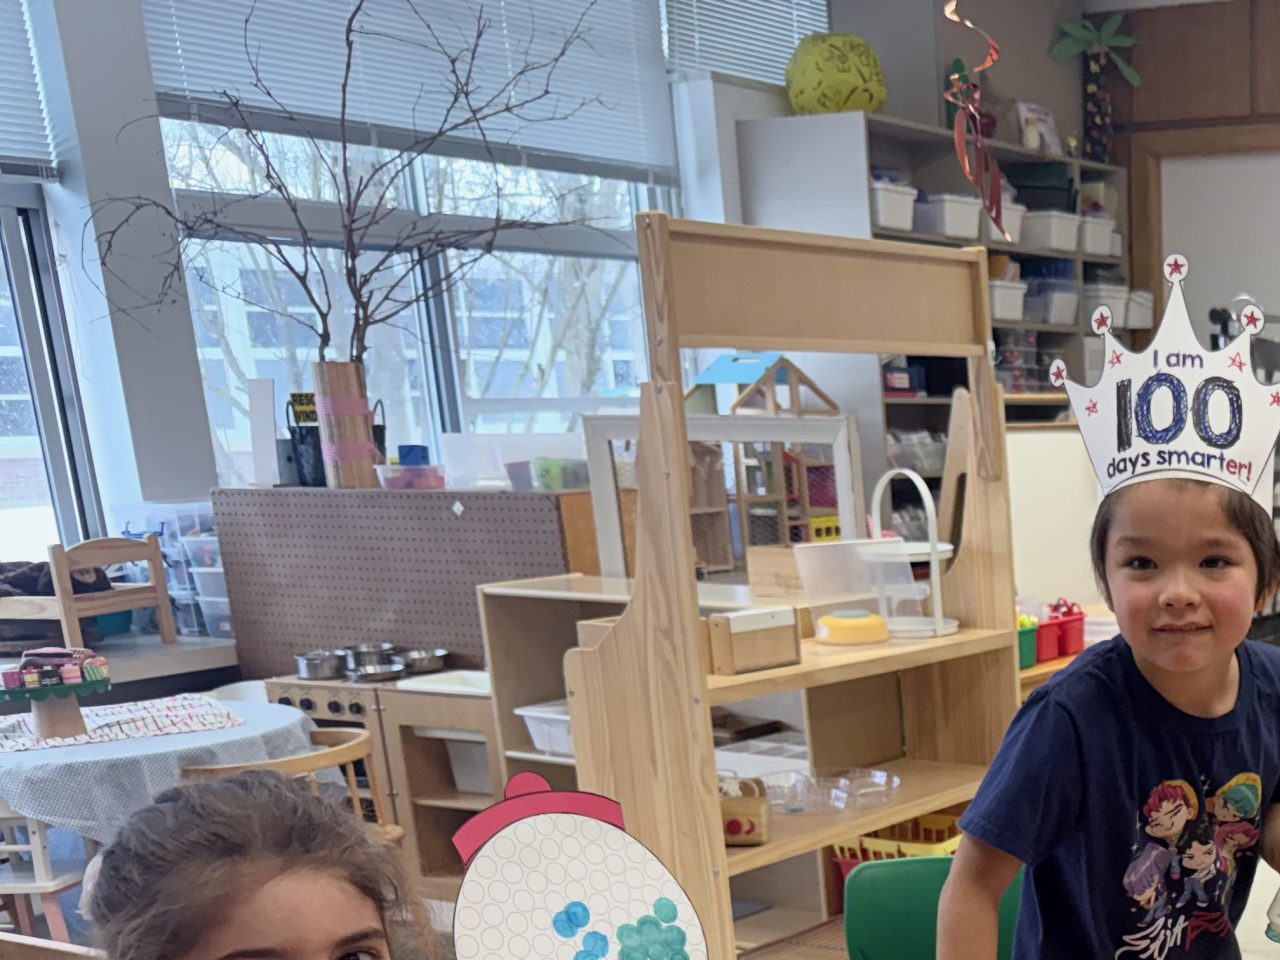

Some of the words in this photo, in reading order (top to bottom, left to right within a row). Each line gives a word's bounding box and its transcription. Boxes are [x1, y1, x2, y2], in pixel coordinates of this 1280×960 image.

[1152, 350, 1159, 369] I
[1165, 352, 1204, 369] am
[1116, 370, 1243, 453] 100
[1107, 452, 1151, 479] days
[1156, 448, 1253, 482] smarter!
